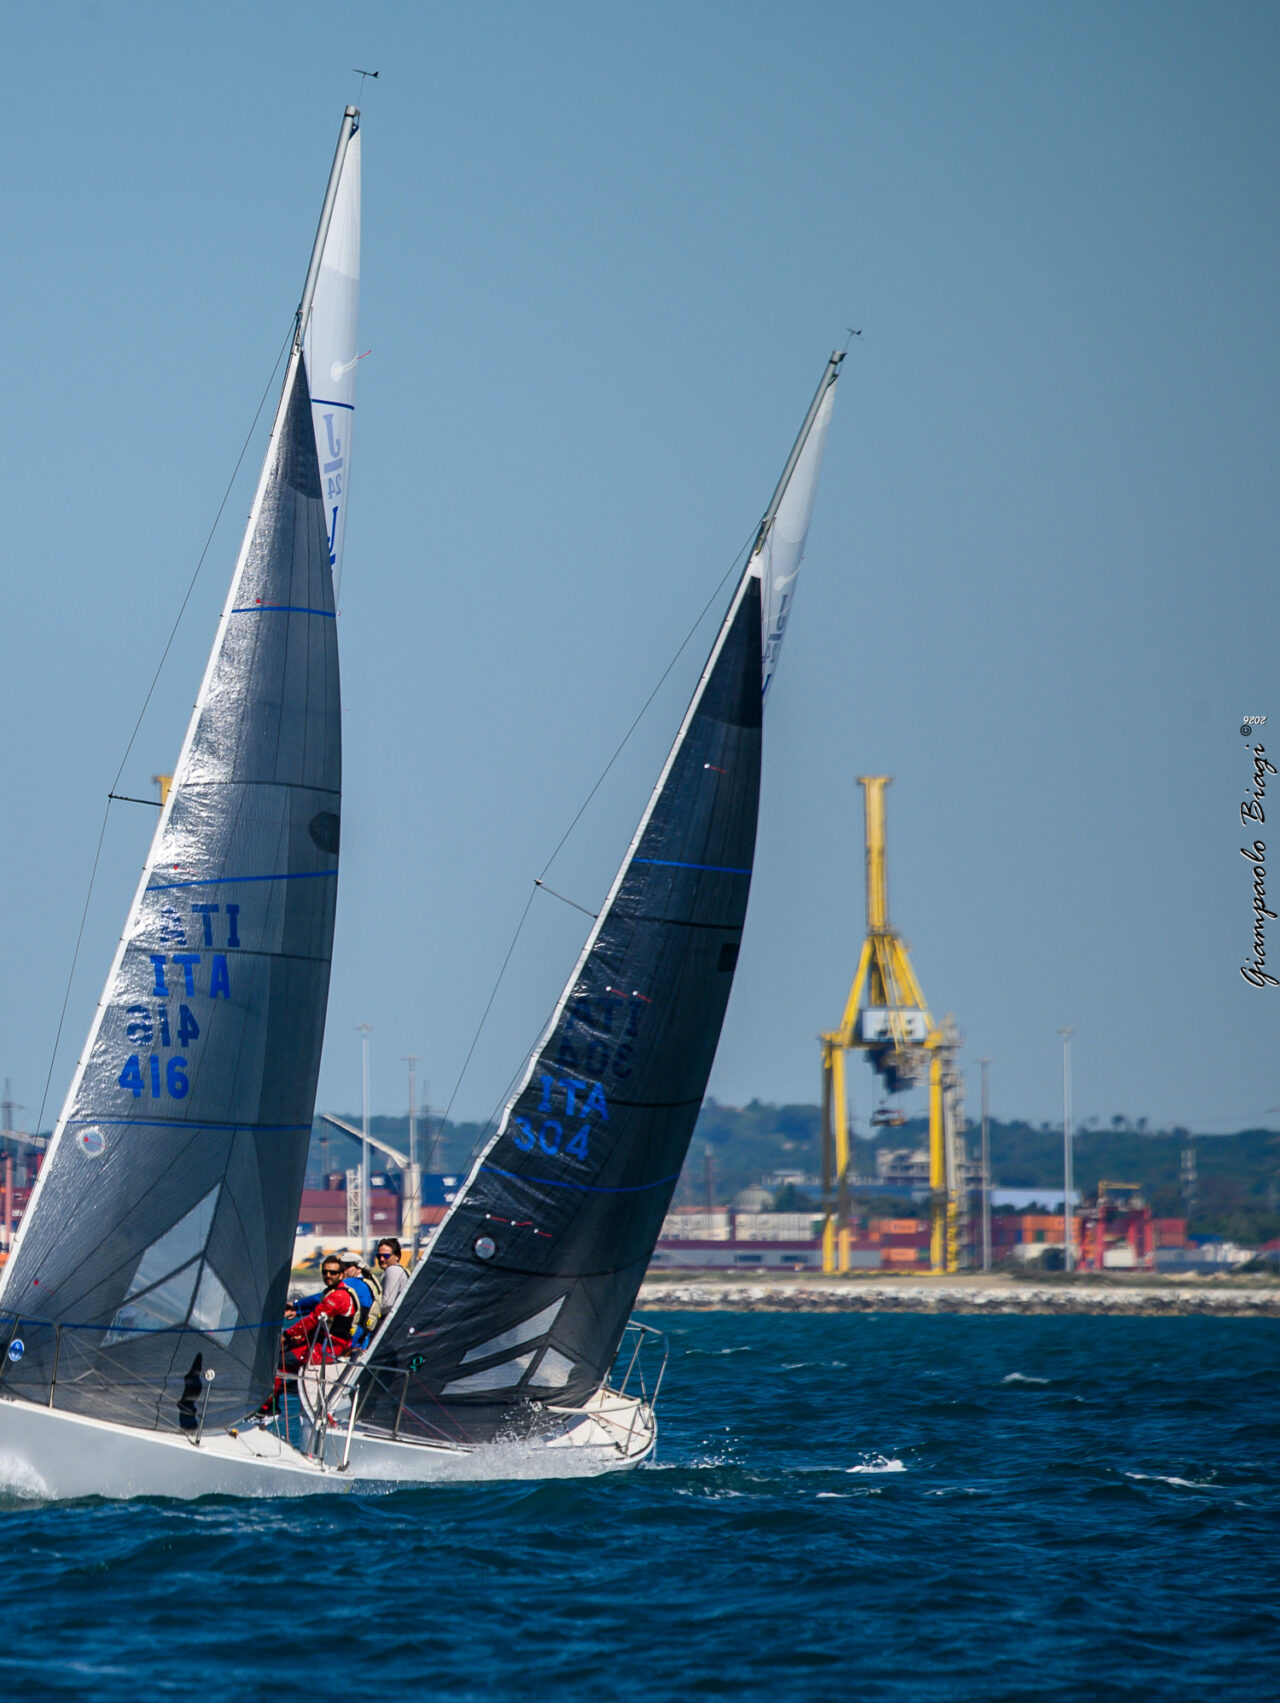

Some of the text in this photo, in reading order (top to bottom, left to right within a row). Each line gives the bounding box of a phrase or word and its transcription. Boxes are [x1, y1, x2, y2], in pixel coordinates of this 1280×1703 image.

[150, 954, 231, 999] ITA
[118, 1054, 190, 1099] 416
[537, 1075, 609, 1121] ITA
[514, 1116, 592, 1161] 304
